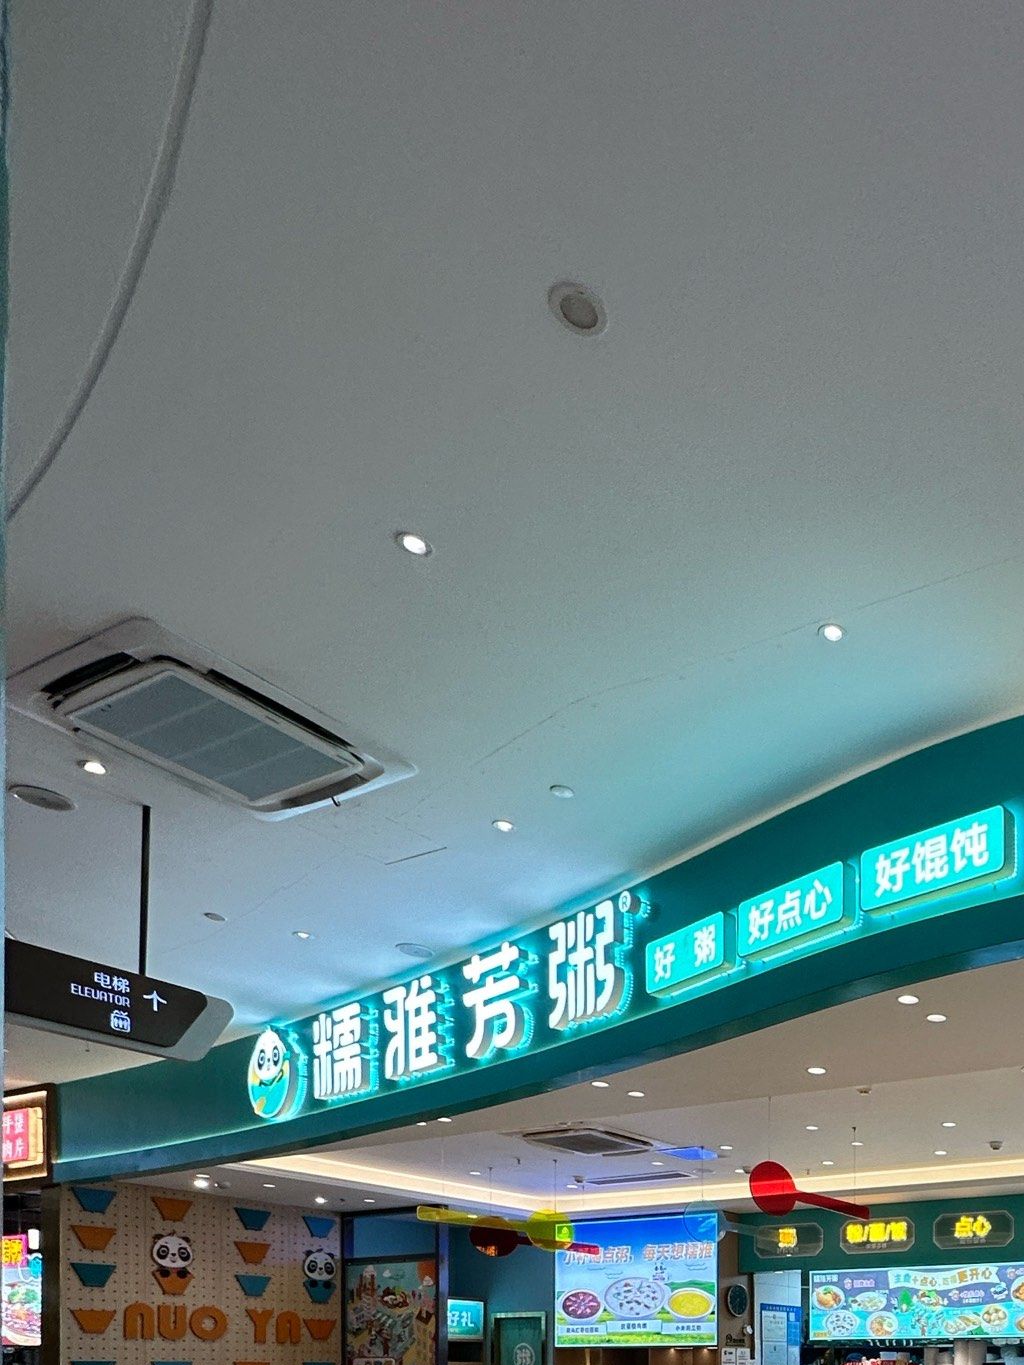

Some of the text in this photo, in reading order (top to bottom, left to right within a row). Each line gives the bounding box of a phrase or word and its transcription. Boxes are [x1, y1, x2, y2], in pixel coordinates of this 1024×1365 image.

[875, 822, 990, 895] 好馄饨
[747, 880, 834, 942] 好点心
[70, 983, 131, 1008] ELEVATOR
[94, 971, 130, 993] 电梯
[312, 898, 617, 1101] 糯雅芳粥
[954, 1215, 992, 1238] 点心
[123, 1302, 301, 1344] NUO YA
